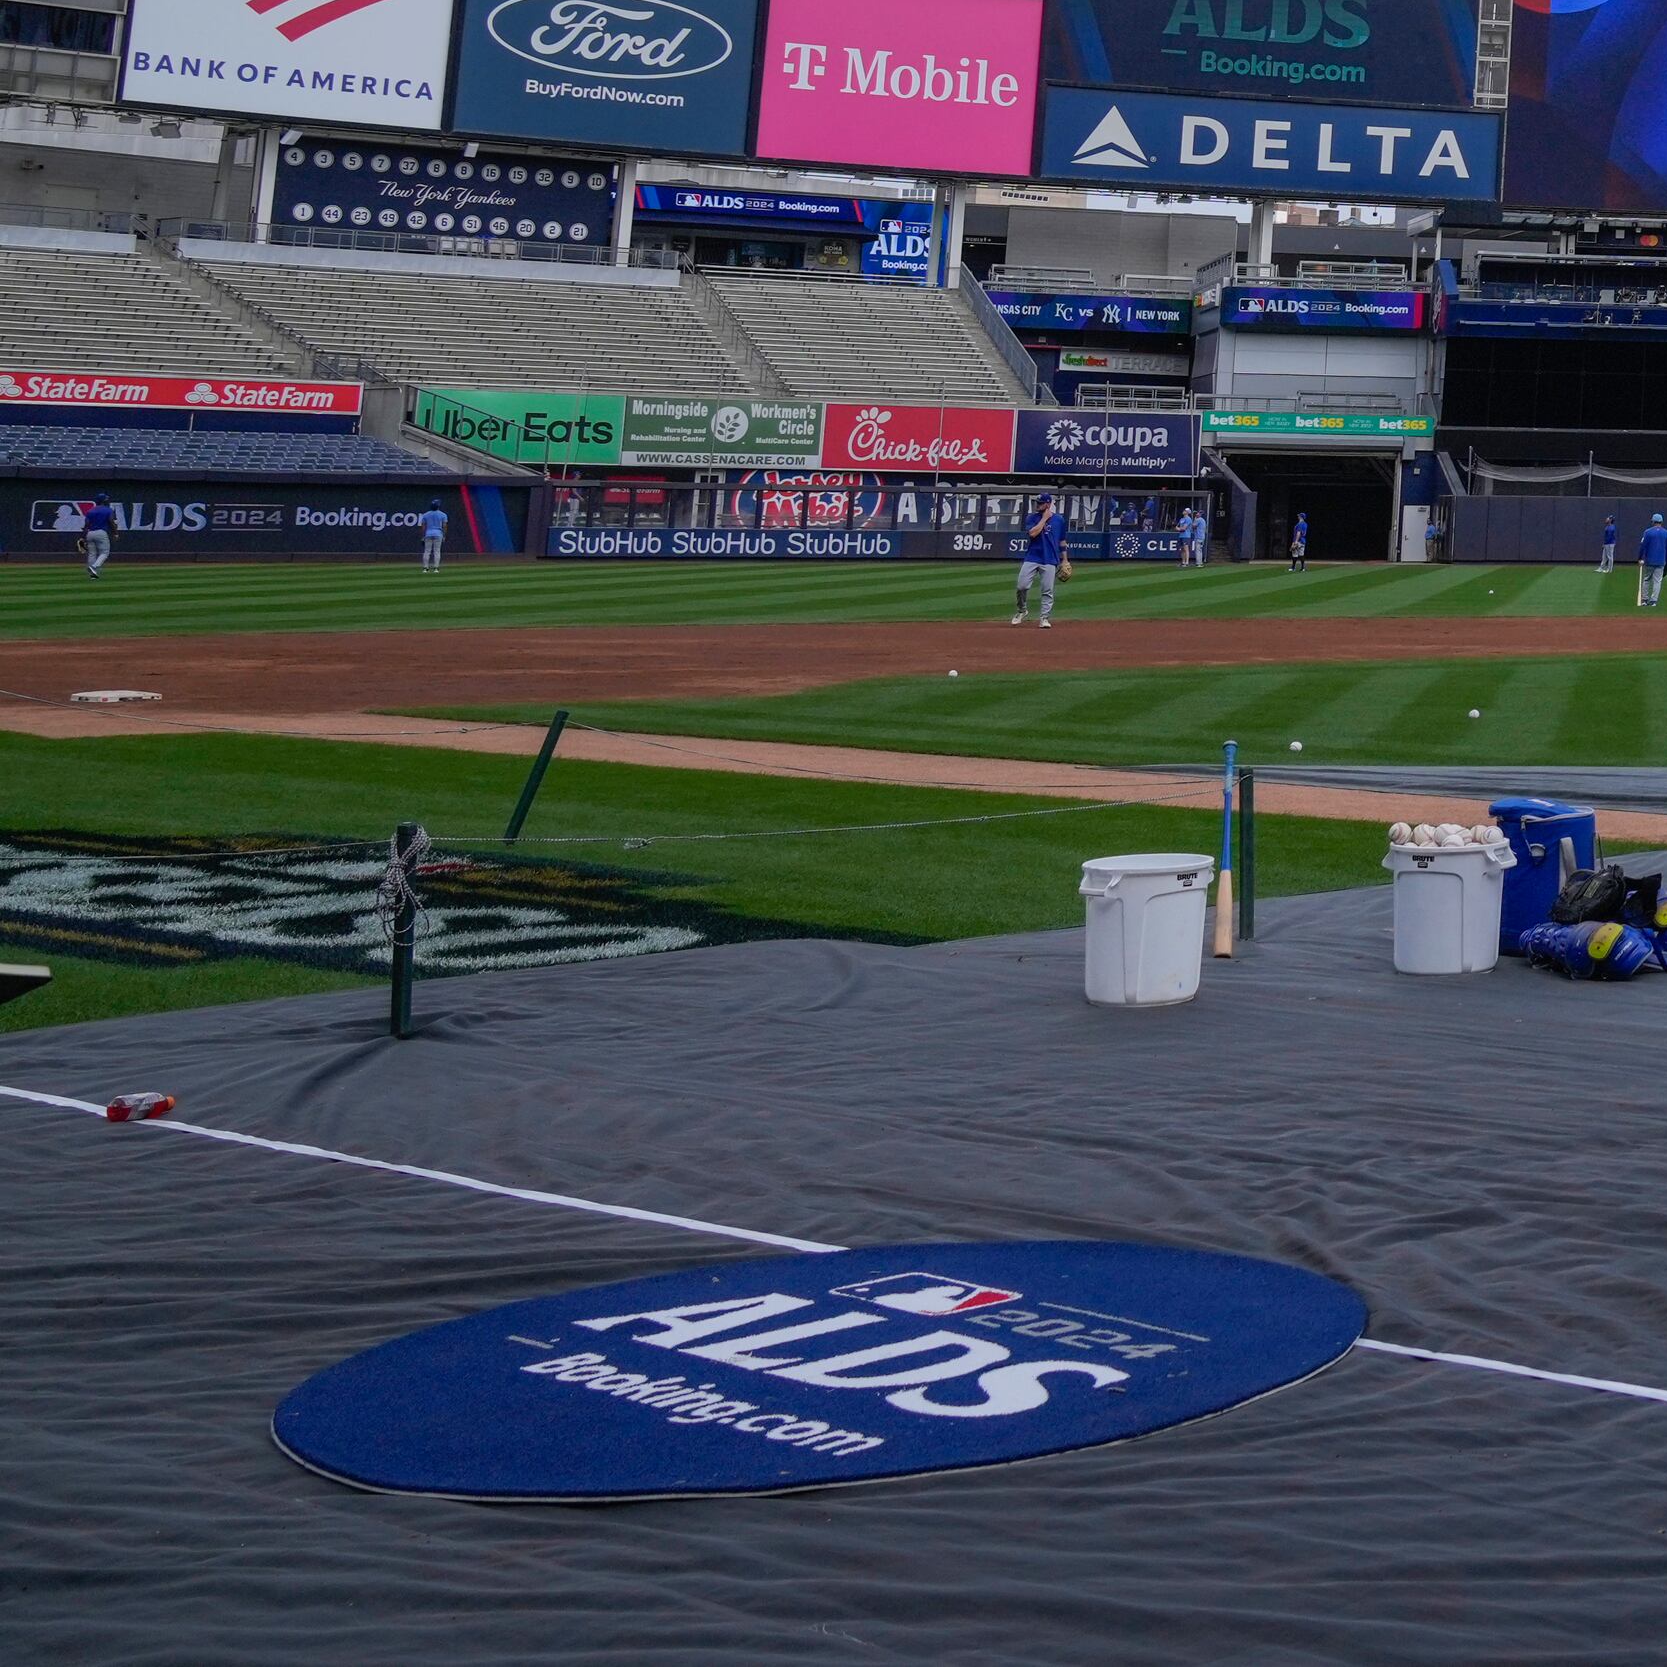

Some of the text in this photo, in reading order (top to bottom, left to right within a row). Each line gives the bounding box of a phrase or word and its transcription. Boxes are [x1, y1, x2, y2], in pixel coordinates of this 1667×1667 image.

[530, 0, 692, 70] Ford
[134, 52, 434, 101] BANK OF AMERICA
[782, 42, 1019, 106] T Mobile
[1200, 50, 1366, 84] Booking.com
[525, 79, 685, 108] BuyFordNow.com
[1180, 114, 1470, 179] DELTA
[378, 180, 516, 210] New York Yankees
[702, 196, 839, 213] ALDS 2024 Booking.com
[1022, 305, 1041, 315] CITY
[1079, 309, 1093, 317] vs
[1136, 310, 1156, 320] NEW
[1157, 311, 1179, 321] YORK
[1266, 300, 1408, 316] ALDS 2024 Booking.com
[633, 400, 708, 419] Morningside
[751, 404, 816, 419] Workmen's
[1210, 414, 1259, 426] bet365
[426, 409, 613, 444] Uber Eats
[779, 420, 814, 435] Circle
[1296, 416, 1344, 428] bet365
[1379, 418, 1427, 430] bet365
[631, 434, 680, 442] Rehabilitation
[848, 418, 987, 467] Chick-fil-A
[1085, 424, 1168, 453] coupa
[636, 453, 806, 466] WWW.CASSENACARE.COM
[1044, 456, 1167, 470] Make Margins Multiply
[213, 510, 283, 525] 2024
[559, 531, 890, 555] StubHub StubHub StubHub
[966, 1306, 1177, 1360] 2024
[573, 1291, 1129, 1419] ALDS
[521, 1350, 886, 1456] Booking.com
